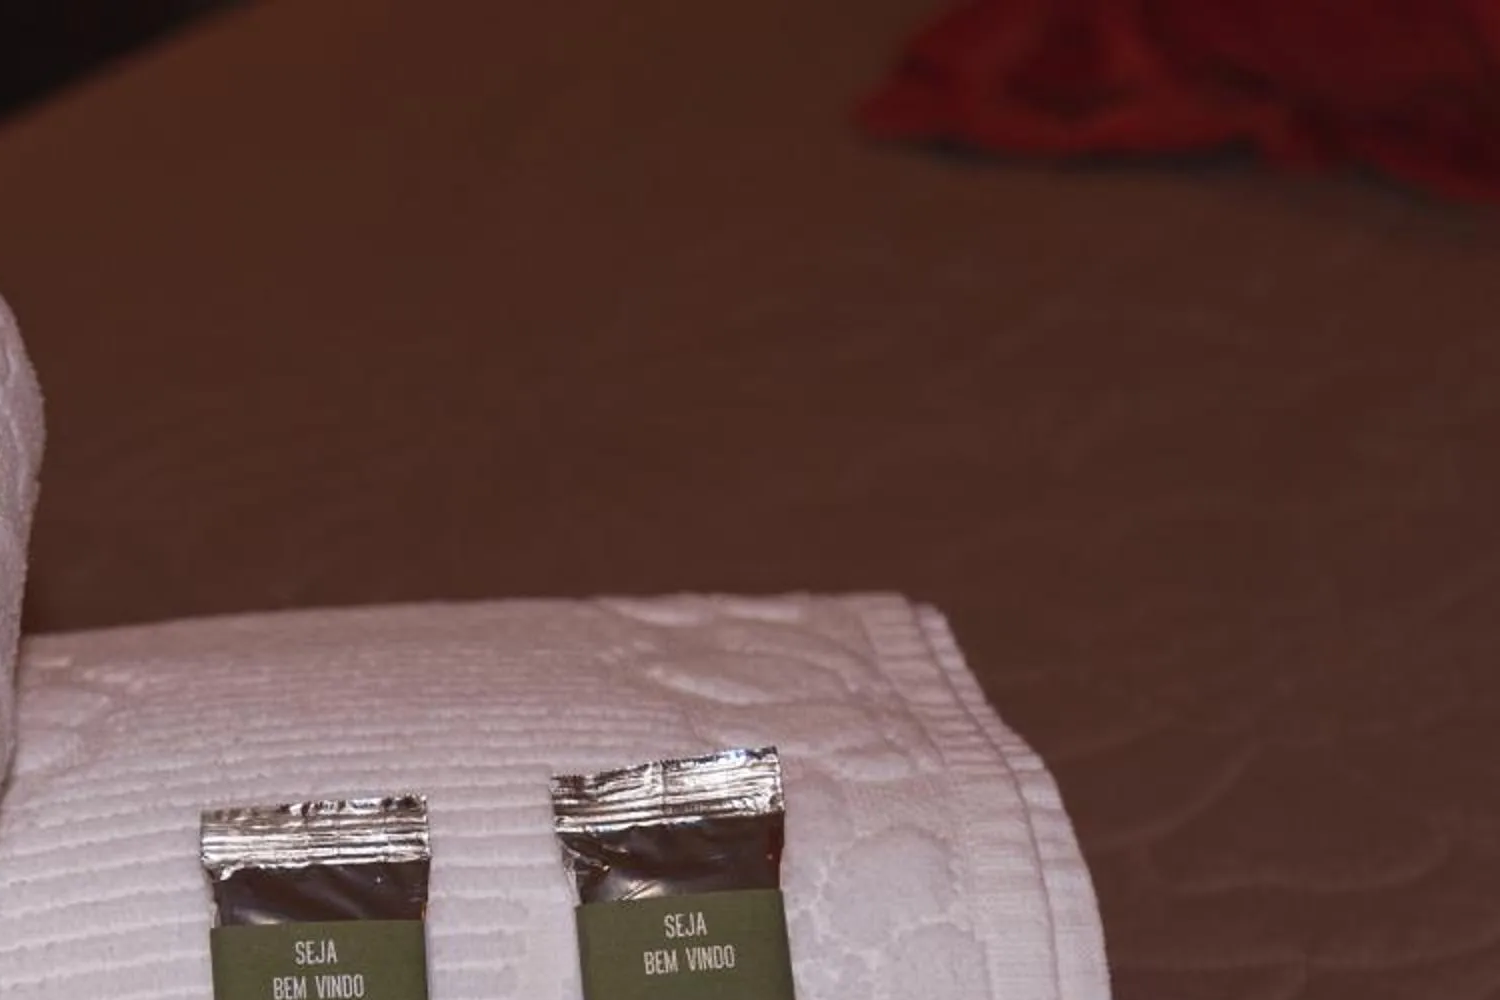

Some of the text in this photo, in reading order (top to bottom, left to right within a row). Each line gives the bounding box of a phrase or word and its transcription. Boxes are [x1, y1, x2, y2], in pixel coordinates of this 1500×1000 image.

[664, 911, 708, 939] SEJA
[295, 938, 338, 965] SEJA
[643, 944, 736, 975] BEM VINDO
[273, 973, 365, 1000] BEM VINDO
